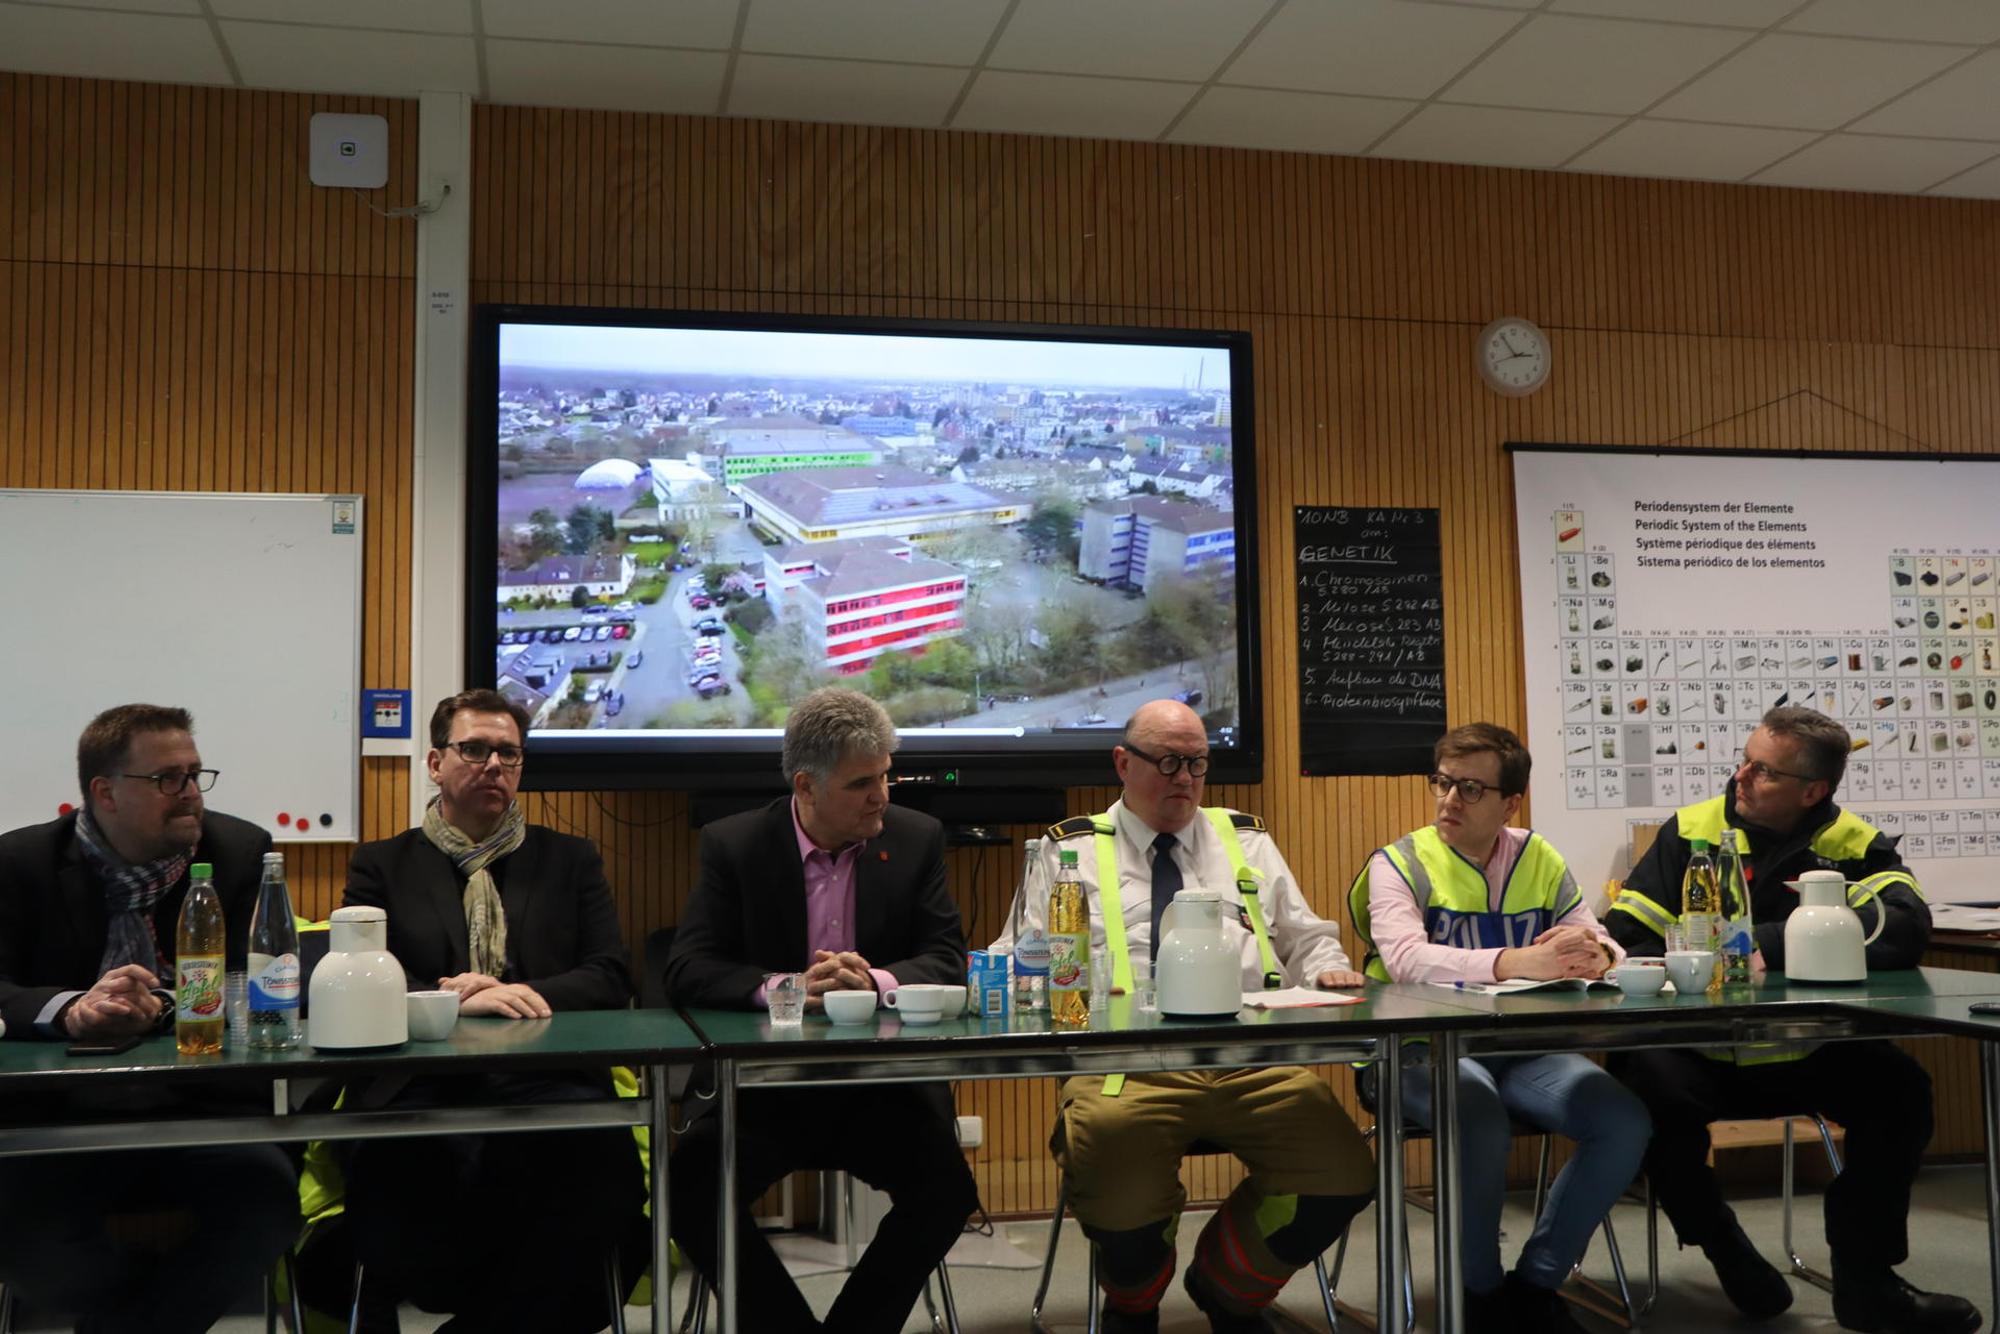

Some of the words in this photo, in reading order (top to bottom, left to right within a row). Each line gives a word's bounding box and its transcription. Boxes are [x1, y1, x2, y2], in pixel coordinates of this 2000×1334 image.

[1634, 501, 1720, 514] Periodensystem
[1724, 502, 1741, 513] der
[1745, 502, 1794, 513] Elemente
[1636, 520, 1679, 531] Periodic
[1682, 521, 1721, 533] System
[1724, 520, 1735, 530] of
[1738, 520, 1755, 531] the
[1758, 521, 1807, 532] Elements
[1636, 538, 1682, 550] Système
[1686, 538, 1743, 551] périodique
[1746, 540, 1764, 550] des
[1767, 539, 1816, 550] éléments
[1299, 546, 1394, 562] GENETIK
[1568, 556, 1575, 564] Li
[1637, 556, 1681, 567] Sistema
[1684, 556, 1733, 569] periódico
[1736, 557, 1749, 567] de
[1752, 558, 1767, 568] los
[1770, 558, 1826, 568] elementos
[1315, 570, 1428, 586] Chromosomen
[1569, 599, 1583, 607] Na
[1599, 599, 1614, 608] Mg
[1601, 641, 1613, 650] Ca
[1630, 641, 1640, 649] Sc
[1714, 641, 1724, 649] Cr
[1741, 640, 1756, 649] Mn
[1768, 640, 1778, 648] Fe
[1796, 640, 1808, 648] Co
[1823, 640, 1833, 648] Ni
[1850, 640, 1862, 648] Cu
[1878, 640, 1889, 648] Zn
[1904, 640, 1916, 648] Ga
[1410, 672, 1441, 689] DNA
[1573, 684, 1585, 693] Rb
[1660, 683, 1670, 691] Zr
[1688, 682, 1701, 691] Nb
[1716, 682, 1730, 691] Mo
[1854, 681, 1866, 691] Ag
[1879, 681, 1892, 689] Cd
[1575, 727, 1586, 735] Cs
[1605, 726, 1616, 735] Ba
[1662, 725, 1672, 734] Hf
[1690, 725, 1700, 733] Ta
[1856, 722, 1867, 731] Au
[1882, 721, 1894, 732] Hg
[1935, 720, 1946, 729] Pb
[1576, 770, 1585, 778] Fr
[1606, 769, 1617, 777] Ra
[1692, 767, 1705, 776] Db
[1887, 814, 1899, 824] Dy
[1914, 814, 1927, 822] Ho
[1968, 812, 1982, 820] Tm
[1942, 837, 1955, 845] Fm
[1970, 836, 1984, 844] Md
[1432, 910, 1543, 950] POLIZ
